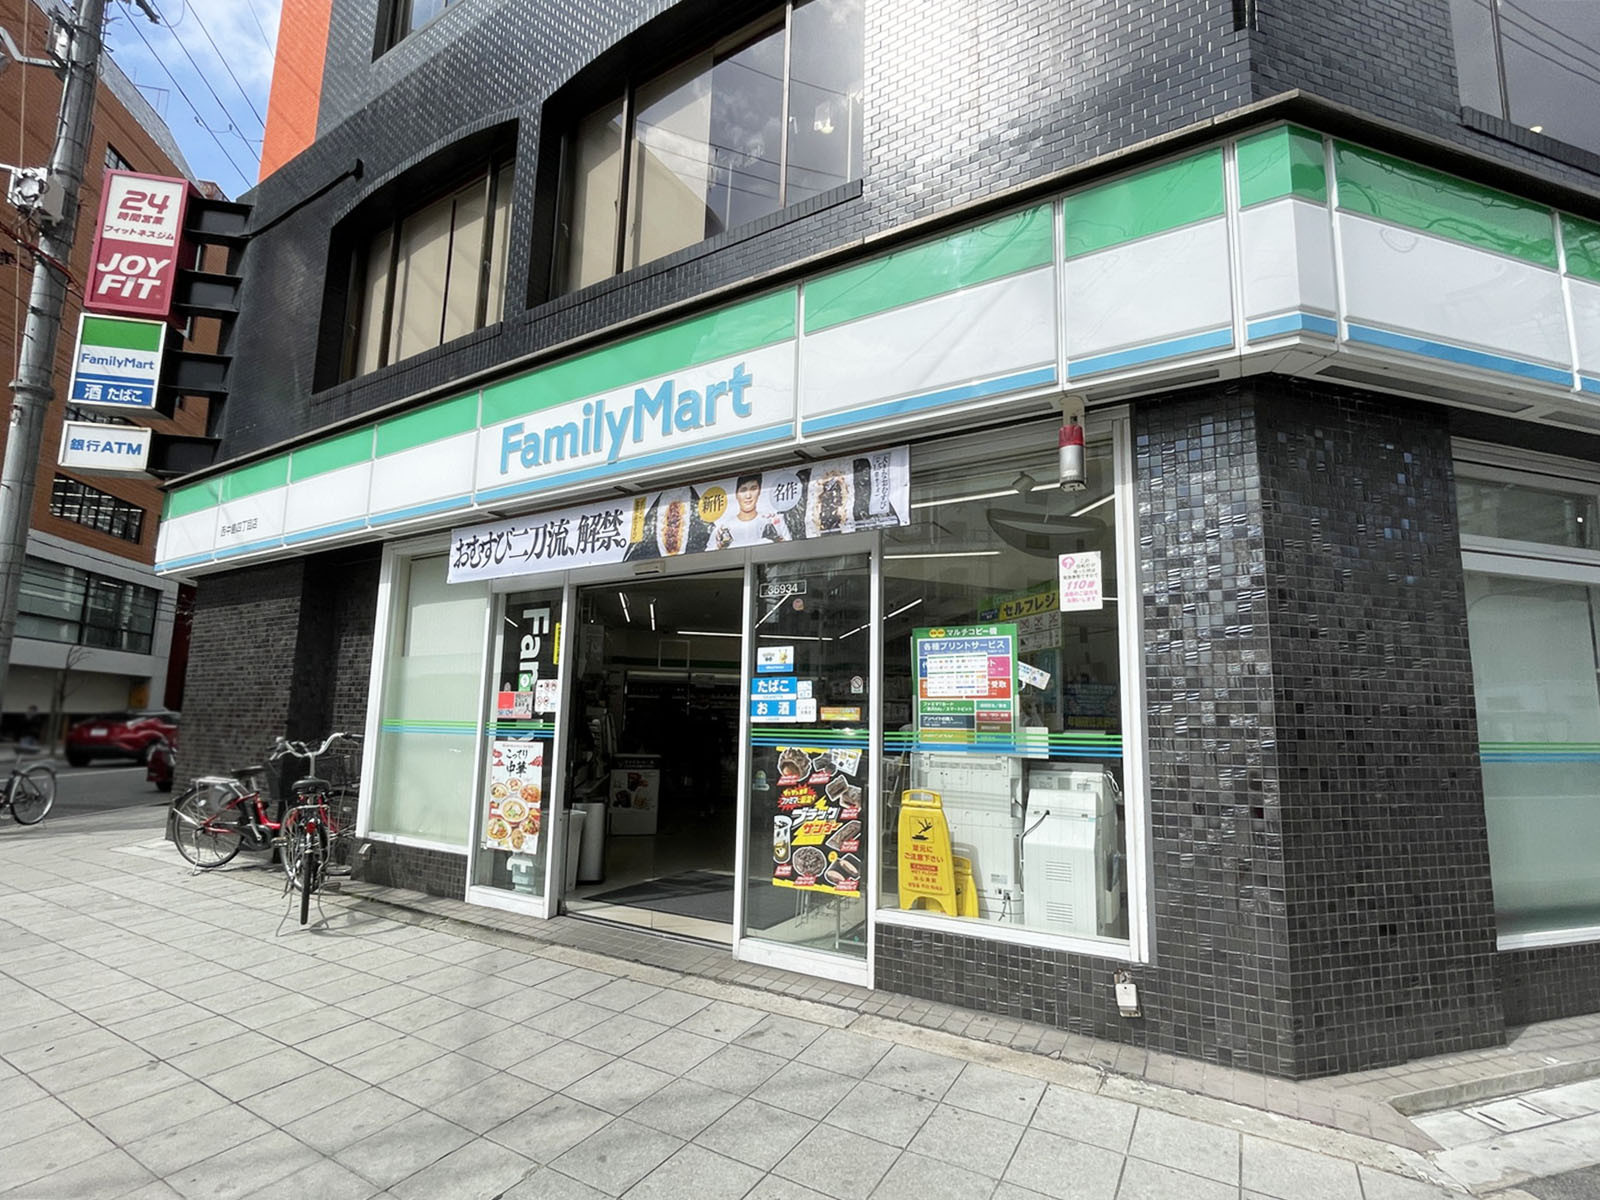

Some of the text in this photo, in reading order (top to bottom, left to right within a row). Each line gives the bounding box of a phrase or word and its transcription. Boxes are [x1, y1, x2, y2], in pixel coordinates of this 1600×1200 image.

[119, 190, 170, 214] 24
[117, 211, 165, 225] 時間営業
[104, 225, 174, 240] フィットネスジム
[97, 253, 171, 278] JOY
[81, 353, 154, 370] FamilyMart
[84, 383, 143, 402] 酒 たばこ
[500, 361, 753, 475] FamilyMart
[70, 438, 142, 456] 銀行ATM
[774, 481, 798, 502] 名作
[702, 490, 724, 513] 新作
[453, 509, 627, 568] おむすび二刀流、解禁。
[767, 583, 798, 595] 36934
[1004, 592, 1056, 616] セルフレジ
[946, 627, 997, 636] マルチコピー機
[924, 640, 1005, 651] 各種プリントサービス
[757, 680, 790, 693] たばこ
[791, 807, 840, 828] ブラック
[803, 822, 839, 835] サンダー
